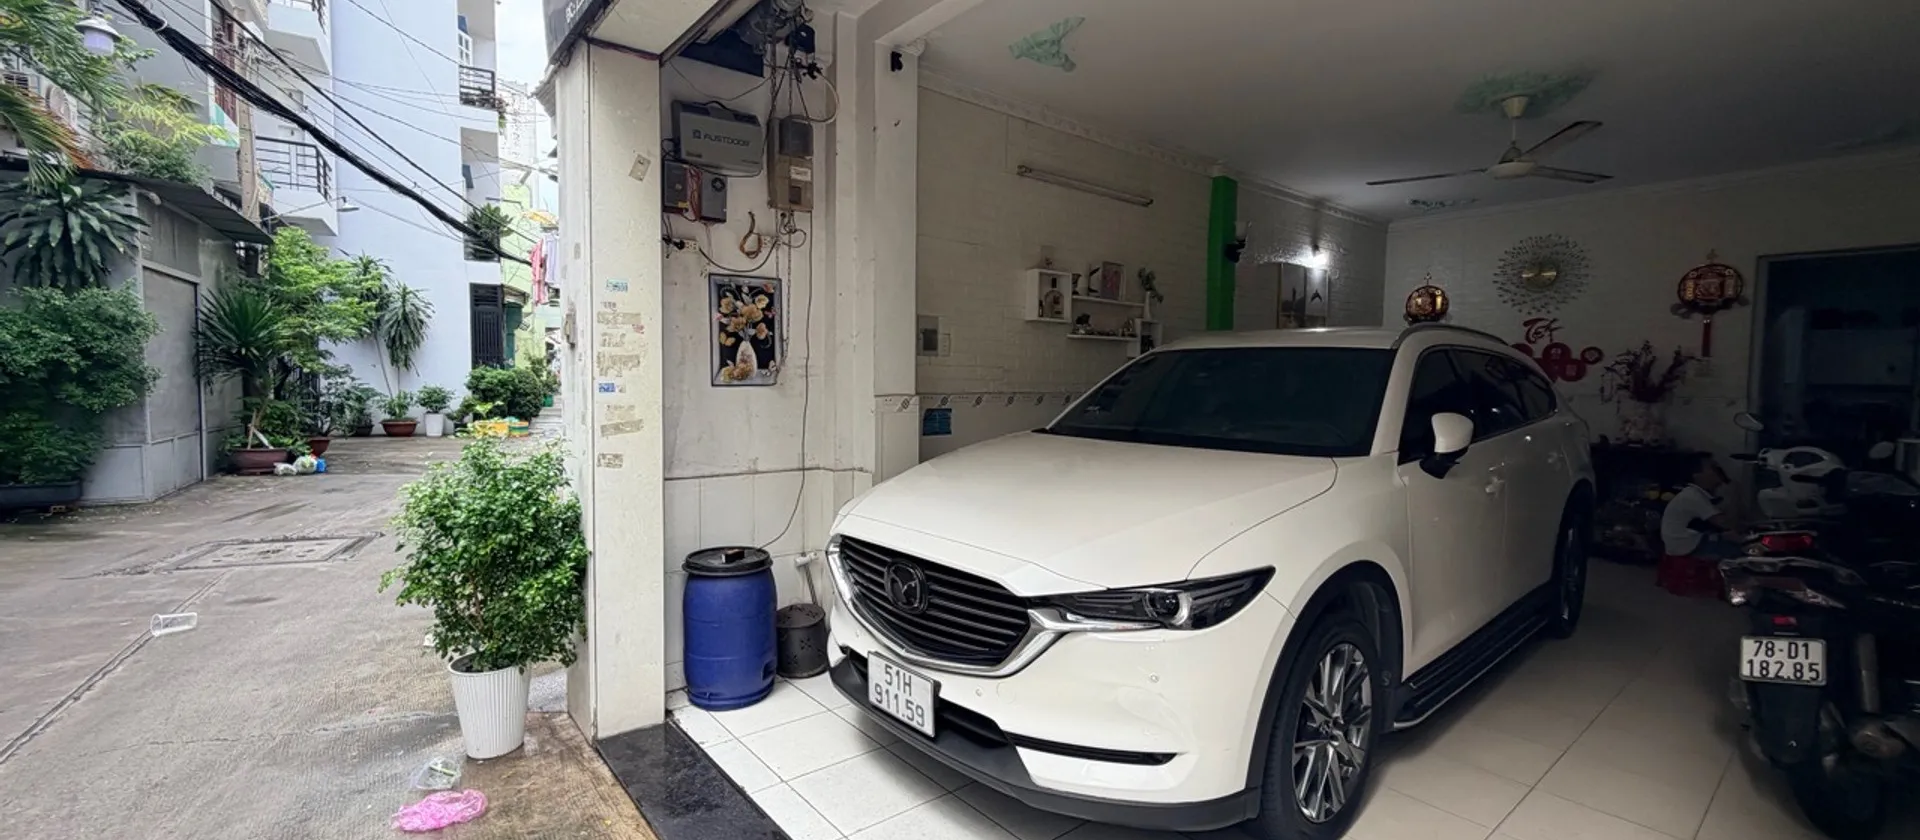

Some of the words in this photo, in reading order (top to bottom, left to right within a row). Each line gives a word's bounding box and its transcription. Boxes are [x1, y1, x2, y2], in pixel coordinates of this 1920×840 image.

[703, 133, 751, 147] AUSTDOOR
[1753, 640, 1809, 660] 78-D1
[884, 663, 912, 697] 51H
[1746, 658, 1820, 681] 182.85
[874, 682, 925, 728] 911.59
